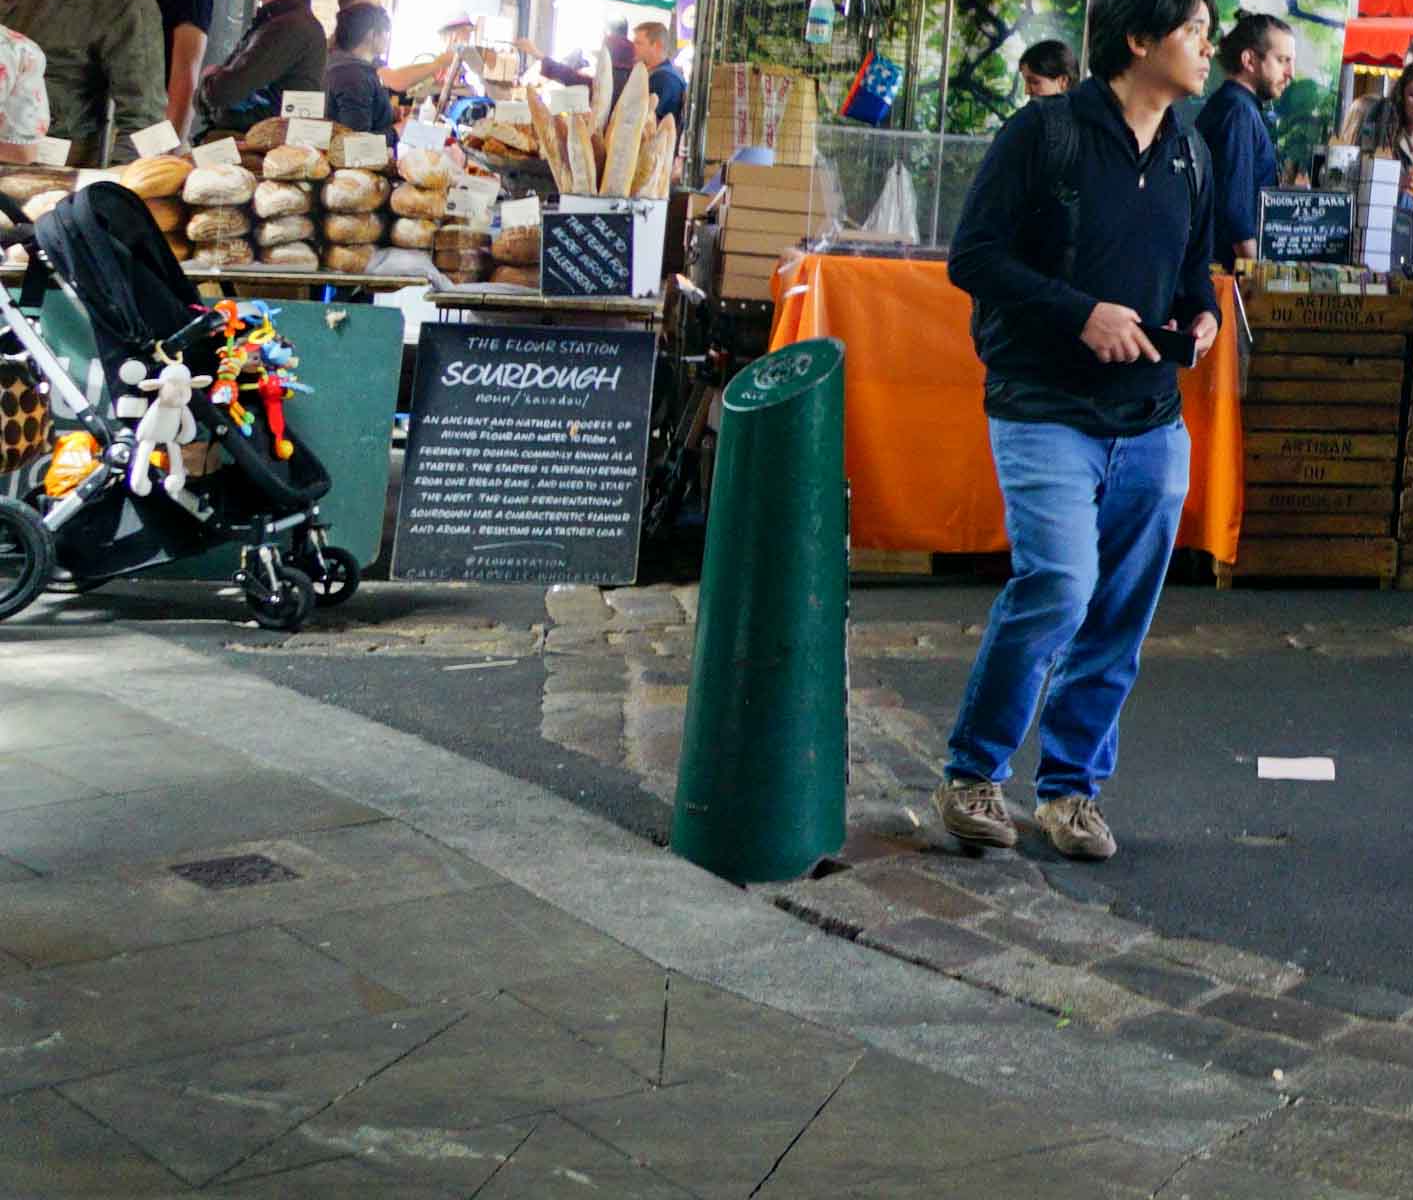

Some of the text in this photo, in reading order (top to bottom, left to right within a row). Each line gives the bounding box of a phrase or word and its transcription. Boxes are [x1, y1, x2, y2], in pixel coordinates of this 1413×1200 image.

[467, 336, 621, 356] THE FLOUR STATION
[441, 360, 622, 392] SOURDOUGH
[422, 414, 440, 425] AN
[441, 415, 490, 427] ANCIENT
[490, 416, 515, 427] AND
[515, 418, 562, 429] NATURAL
[480, 430, 514, 442] FLOUR
[514, 431, 536, 442] AND
[420, 446, 481, 457] FERMENTED
[521, 449, 573, 460] COMMONLY
[574, 450, 609, 461] KNOWN
[472, 462, 494, 473] THE
[495, 463, 538, 474] STARTER
[414, 475, 442, 488] FROM
[468, 477, 503, 489] BREAD
[537, 478, 558, 490] AND
[421, 491, 442, 503] THE
[480, 492, 501, 504] THE
[531, 495, 611, 507] FERMENTATION
[410, 507, 472, 519] SOURDOUGH
[473, 509, 494, 520] HAS
[587, 511, 631, 523] FLAVOUR
[410, 523, 434, 535] AND
